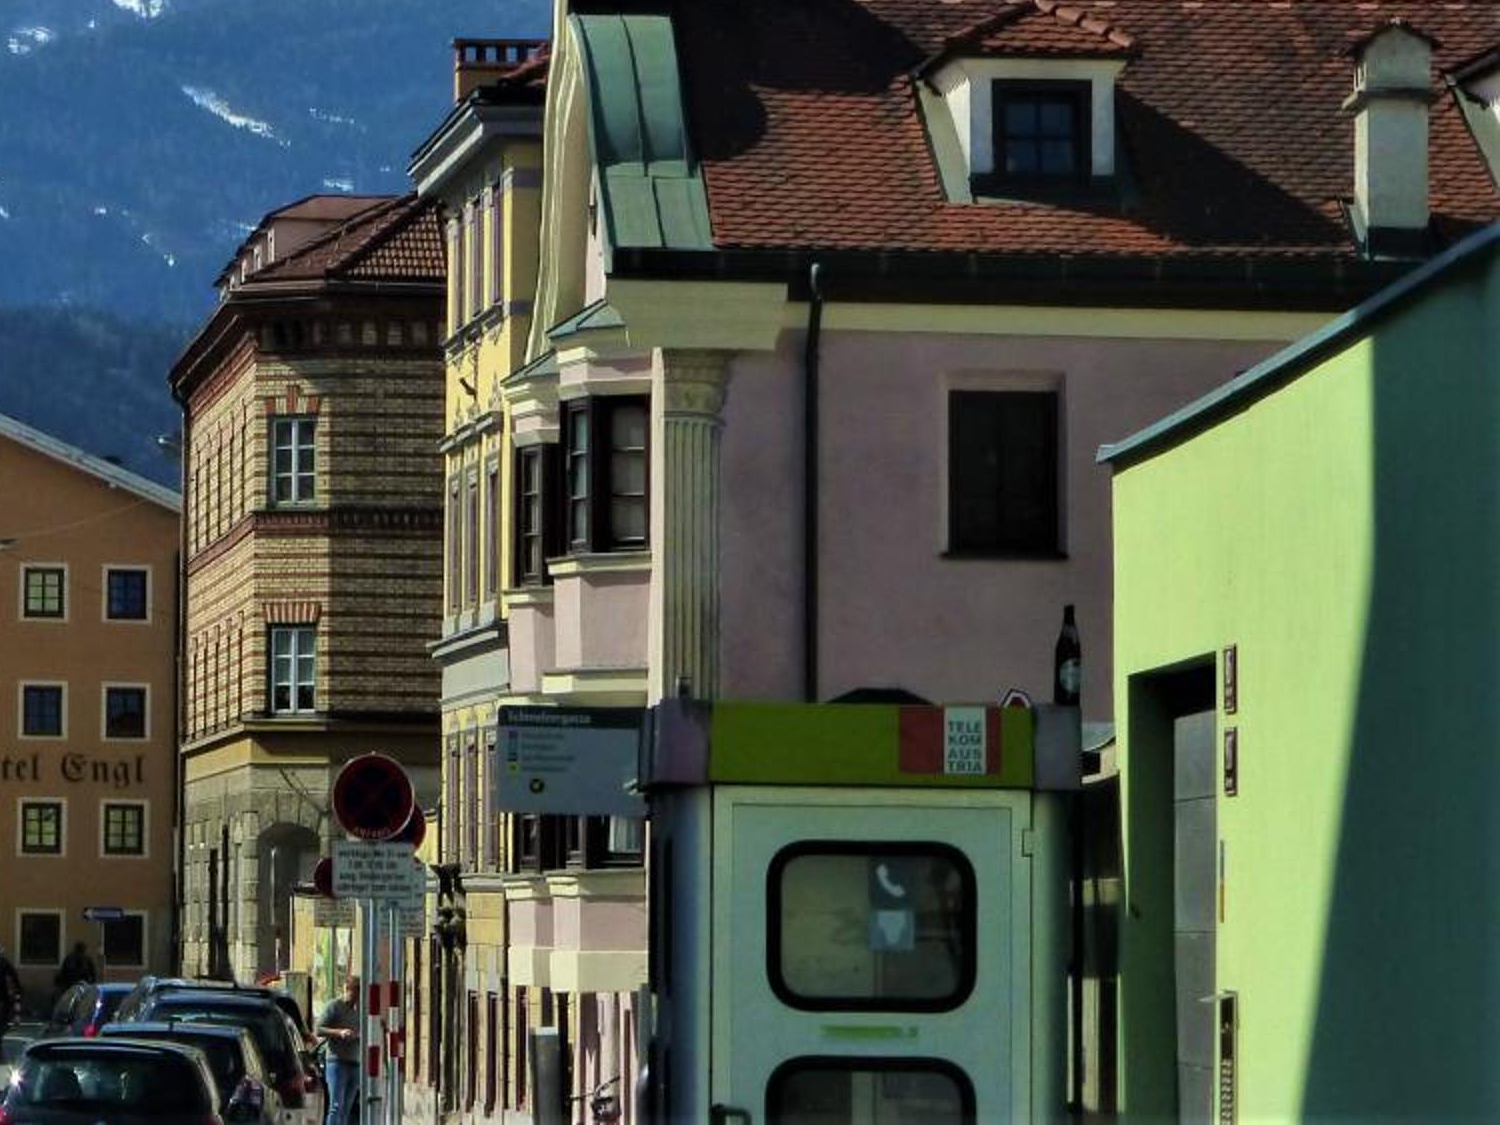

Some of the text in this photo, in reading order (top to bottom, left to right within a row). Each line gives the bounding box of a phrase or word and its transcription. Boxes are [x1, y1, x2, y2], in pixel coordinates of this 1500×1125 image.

[947, 720, 981, 733] TELE
[947, 734, 981, 746] KOM
[947, 748, 981, 760] AUS
[61, 752, 145, 789] Engl
[947, 761, 982, 772] TRIA
